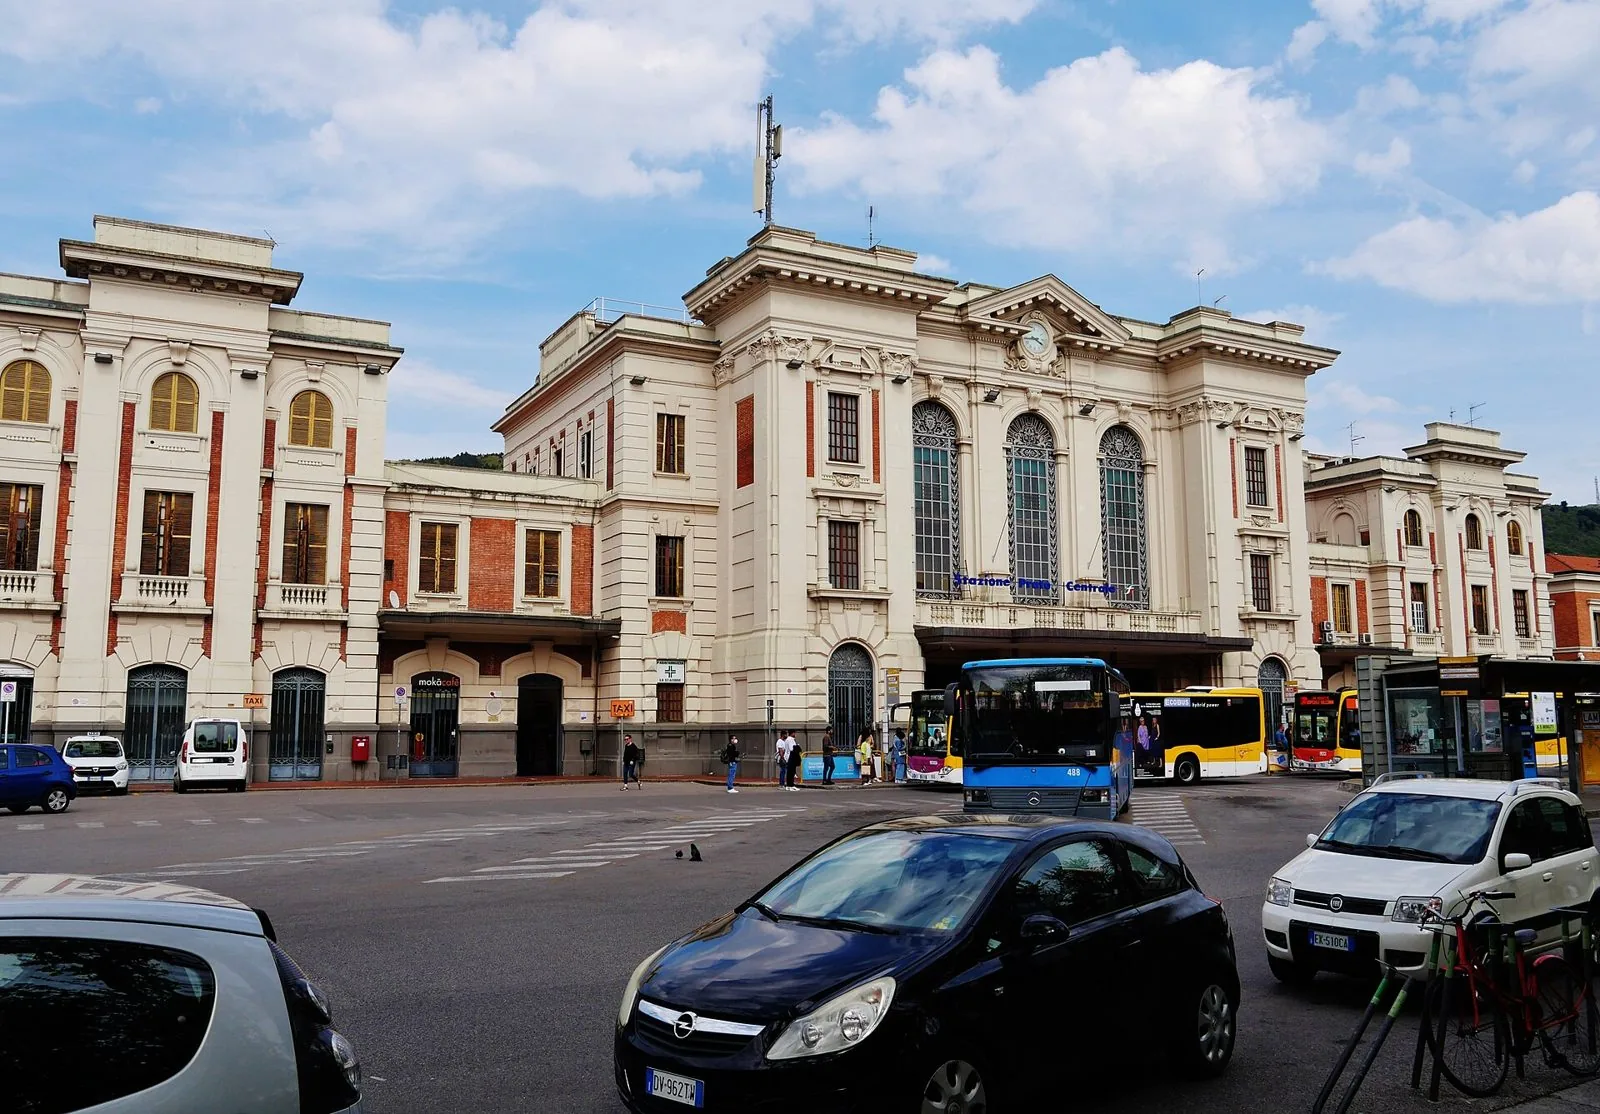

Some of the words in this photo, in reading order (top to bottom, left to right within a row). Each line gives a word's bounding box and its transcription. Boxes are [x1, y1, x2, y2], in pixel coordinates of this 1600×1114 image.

[1066, 581, 1115, 595] Centrale
[612, 703, 633, 713] TAXI
[1067, 768, 1081, 777] 488
